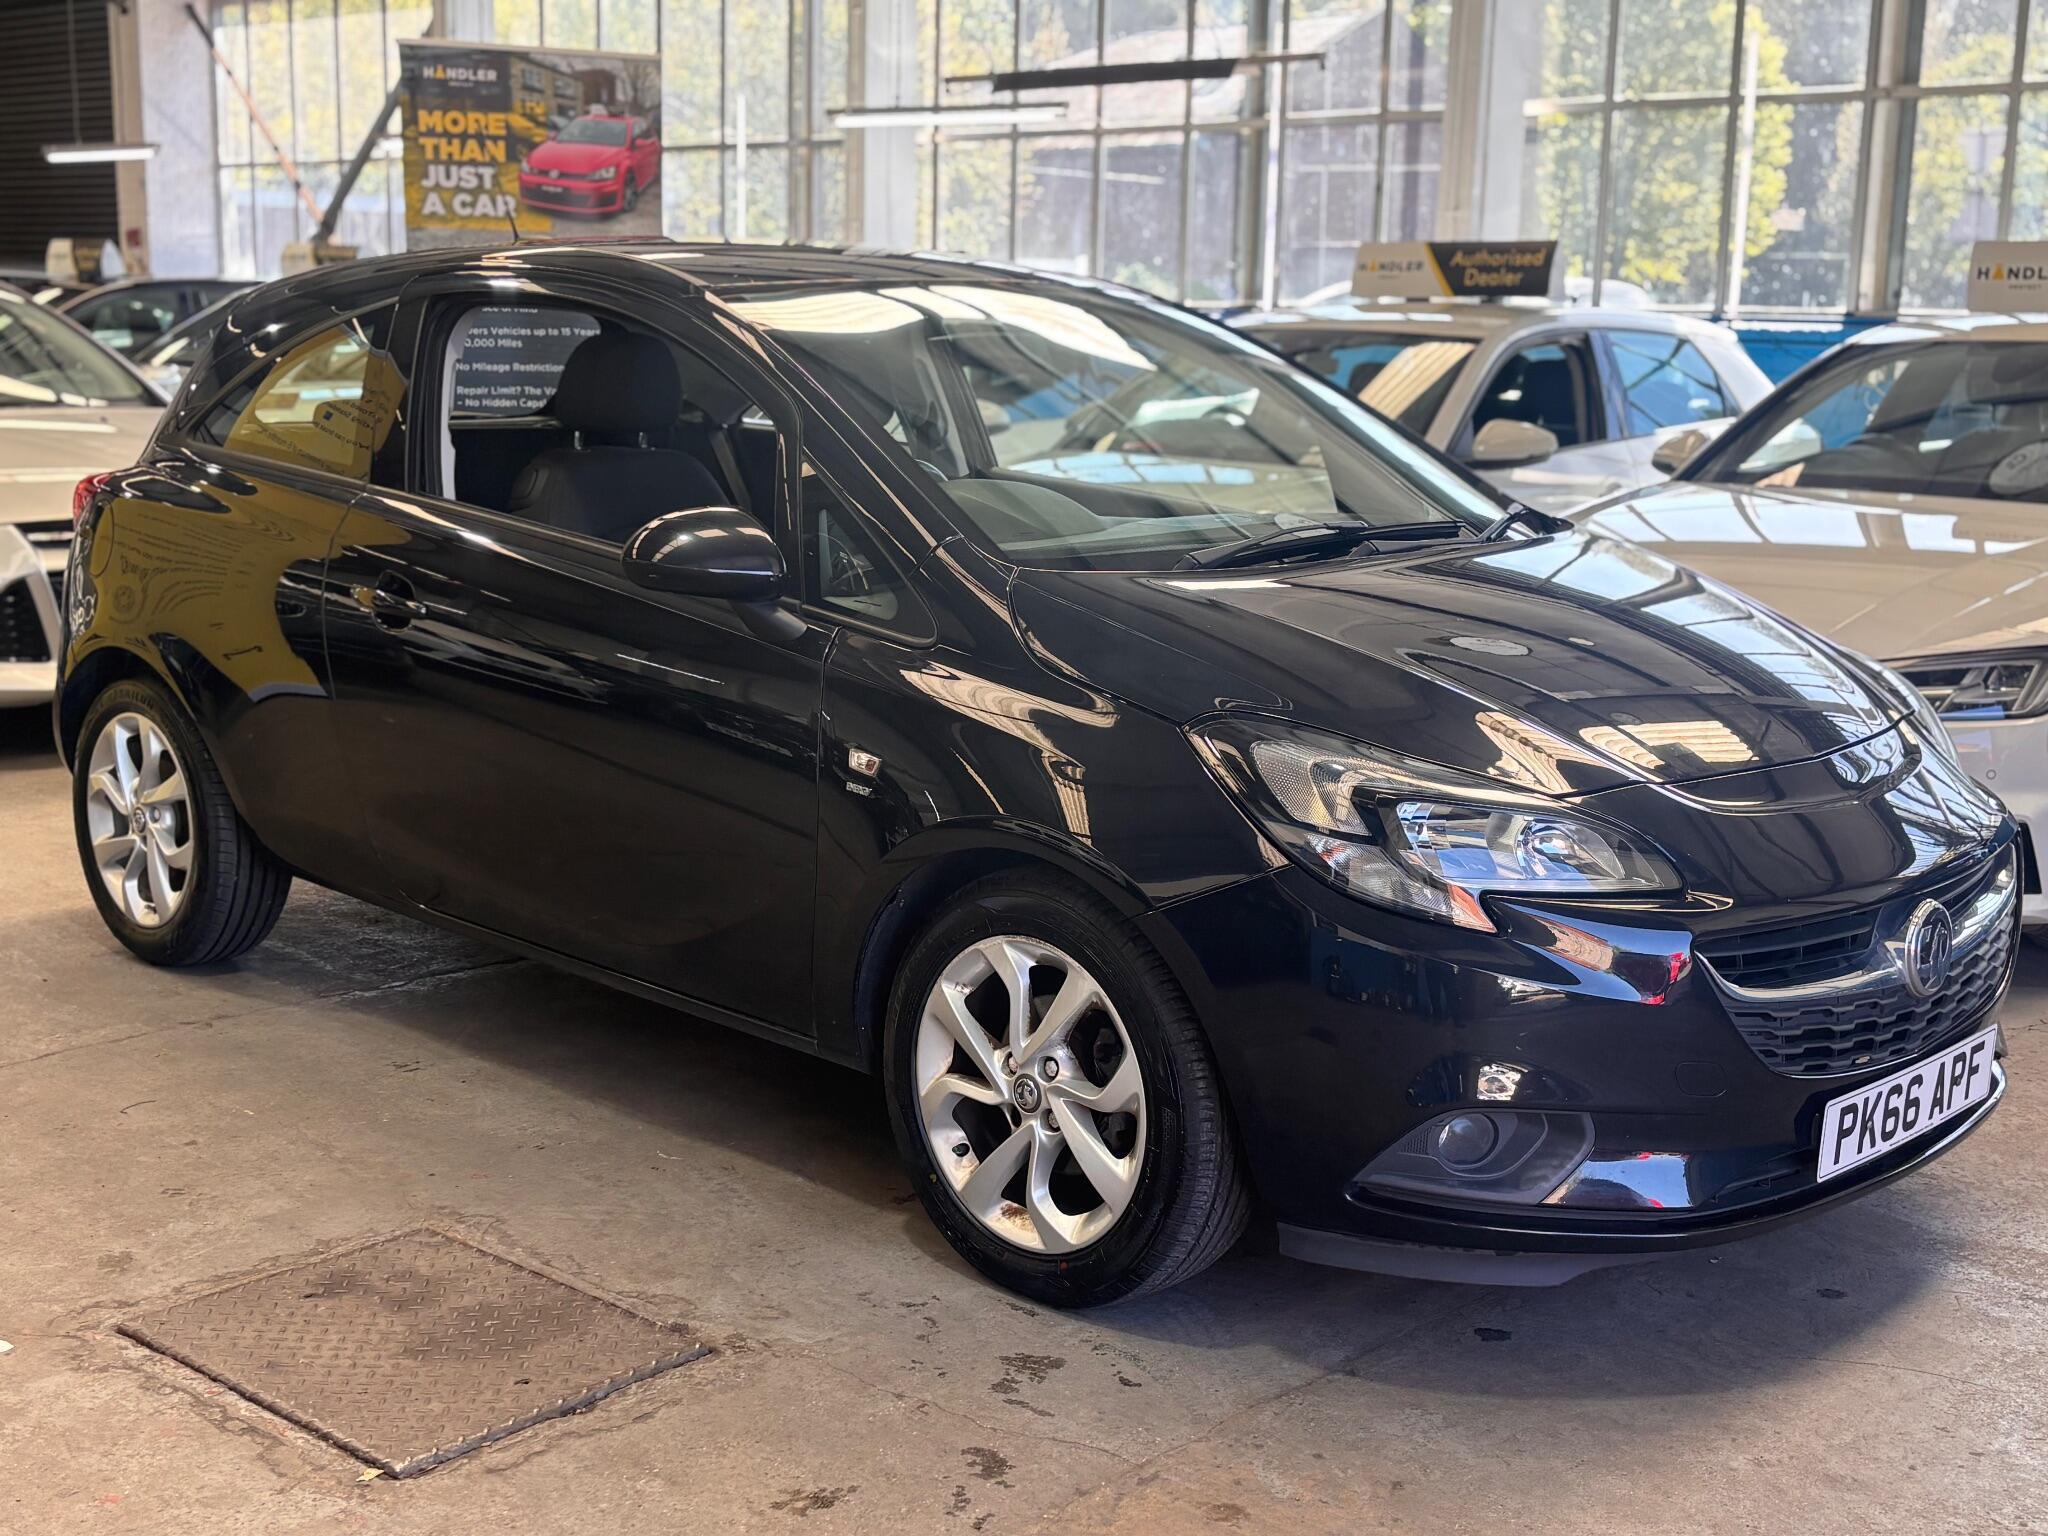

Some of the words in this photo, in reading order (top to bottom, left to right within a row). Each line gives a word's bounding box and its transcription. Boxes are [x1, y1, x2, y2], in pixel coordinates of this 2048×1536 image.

[418, 110, 507, 136] MORE
[419, 137, 507, 163] THAN
[421, 164, 496, 190] JUST
[422, 191, 446, 216] A
[452, 192, 517, 218] CAR
[1449, 248, 1547, 267] Authorised
[1464, 267, 1523, 286] Dealer
[491, 327, 531, 336] Vehicles
[533, 328, 546, 338] up
[548, 327, 559, 336] to
[561, 327, 571, 336] 15
[497, 338, 523, 348] Miles
[456, 362, 470, 371] No
[472, 362, 510, 373] Mileage
[457, 386, 488, 396] Repair
[491, 385, 521, 395] Limit?
[523, 385, 542, 395] The
[465, 398, 480, 407] No
[482, 398, 518, 407] Hidden
[1833, 1073, 1924, 1166] PK66
[1928, 1040, 1986, 1121] APF
